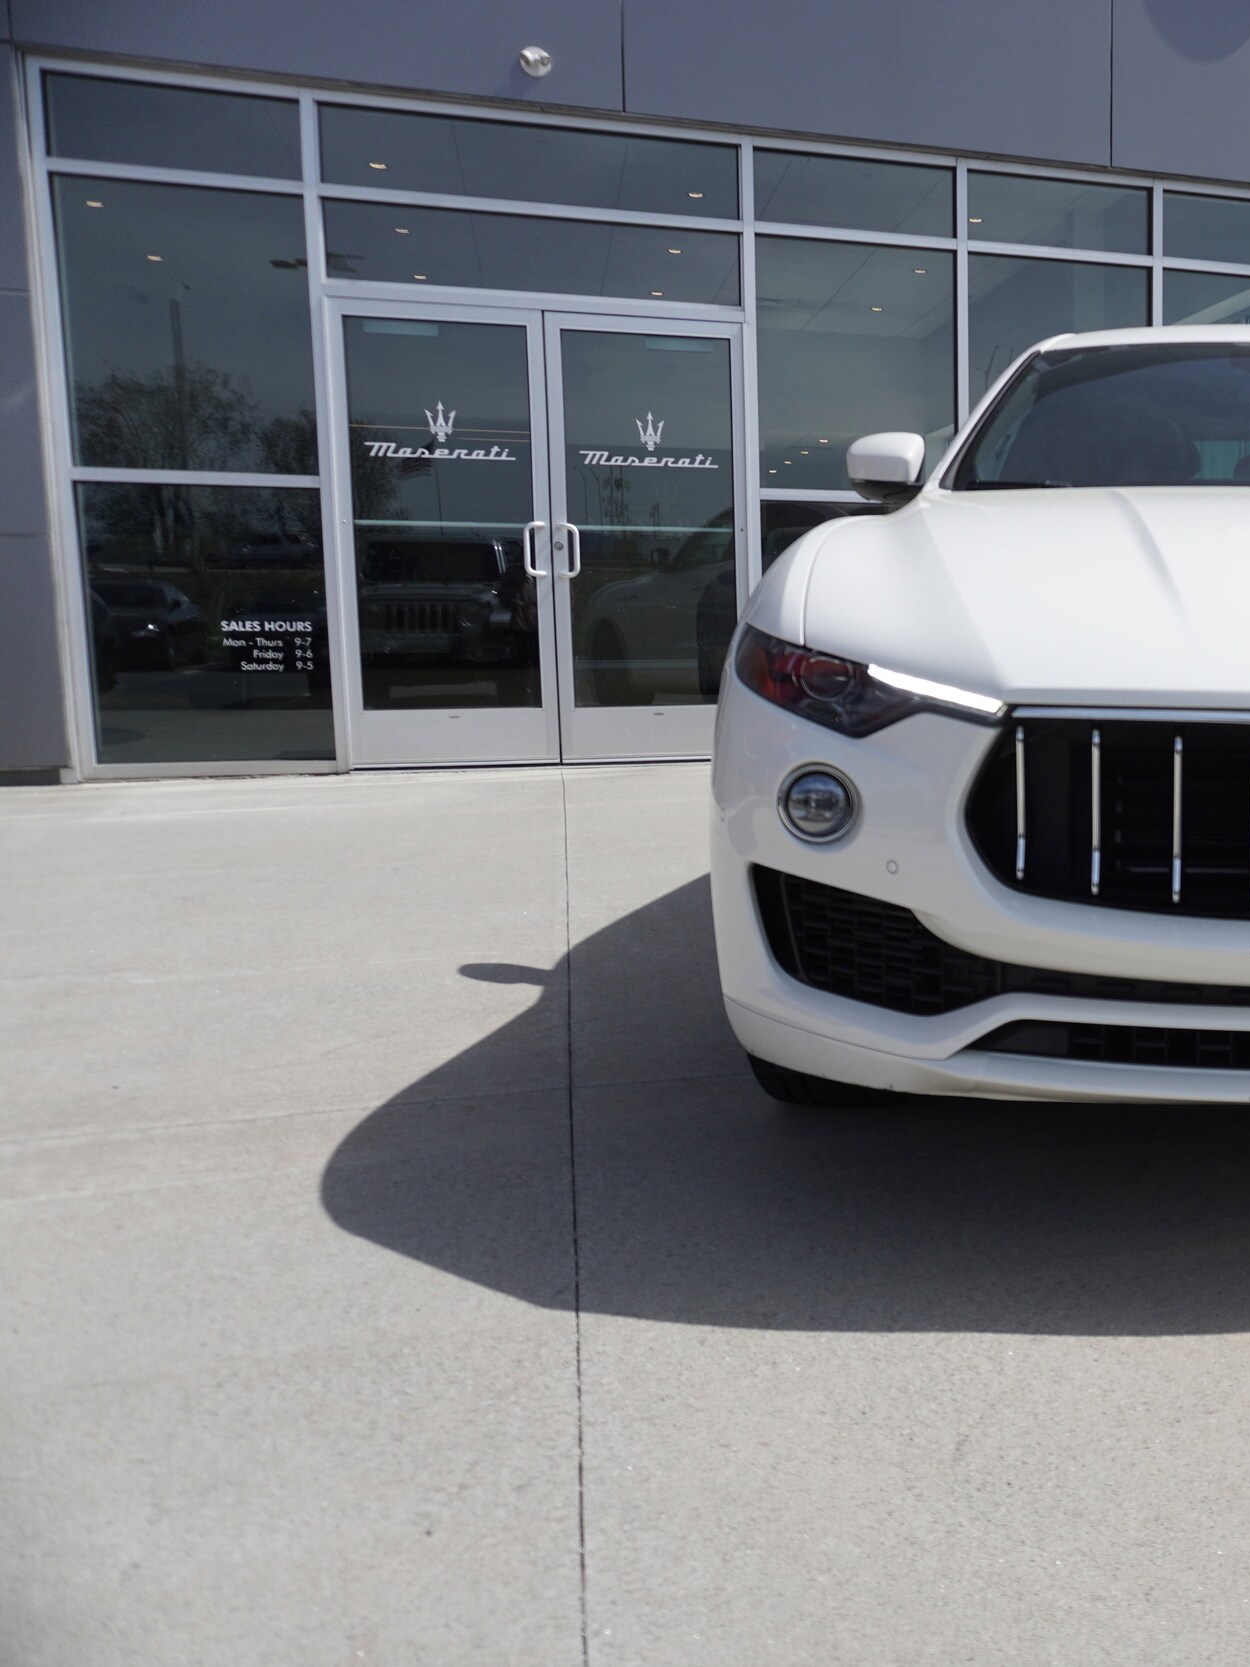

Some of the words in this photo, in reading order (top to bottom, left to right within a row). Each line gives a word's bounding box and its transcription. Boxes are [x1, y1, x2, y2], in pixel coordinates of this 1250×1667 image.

[364, 441, 517, 461] Maserati
[579, 450, 719, 469] Maserati
[221, 621, 261, 632] SALES
[264, 621, 313, 632] HOURS
[222, 637, 247, 647] Mon
[256, 637, 283, 647] Thurs
[294, 637, 313, 647] 9-7
[253, 649, 284, 660] Friday
[295, 649, 314, 659] 9-6
[240, 661, 285, 672] Saturday
[296, 661, 315, 671] 9-5
